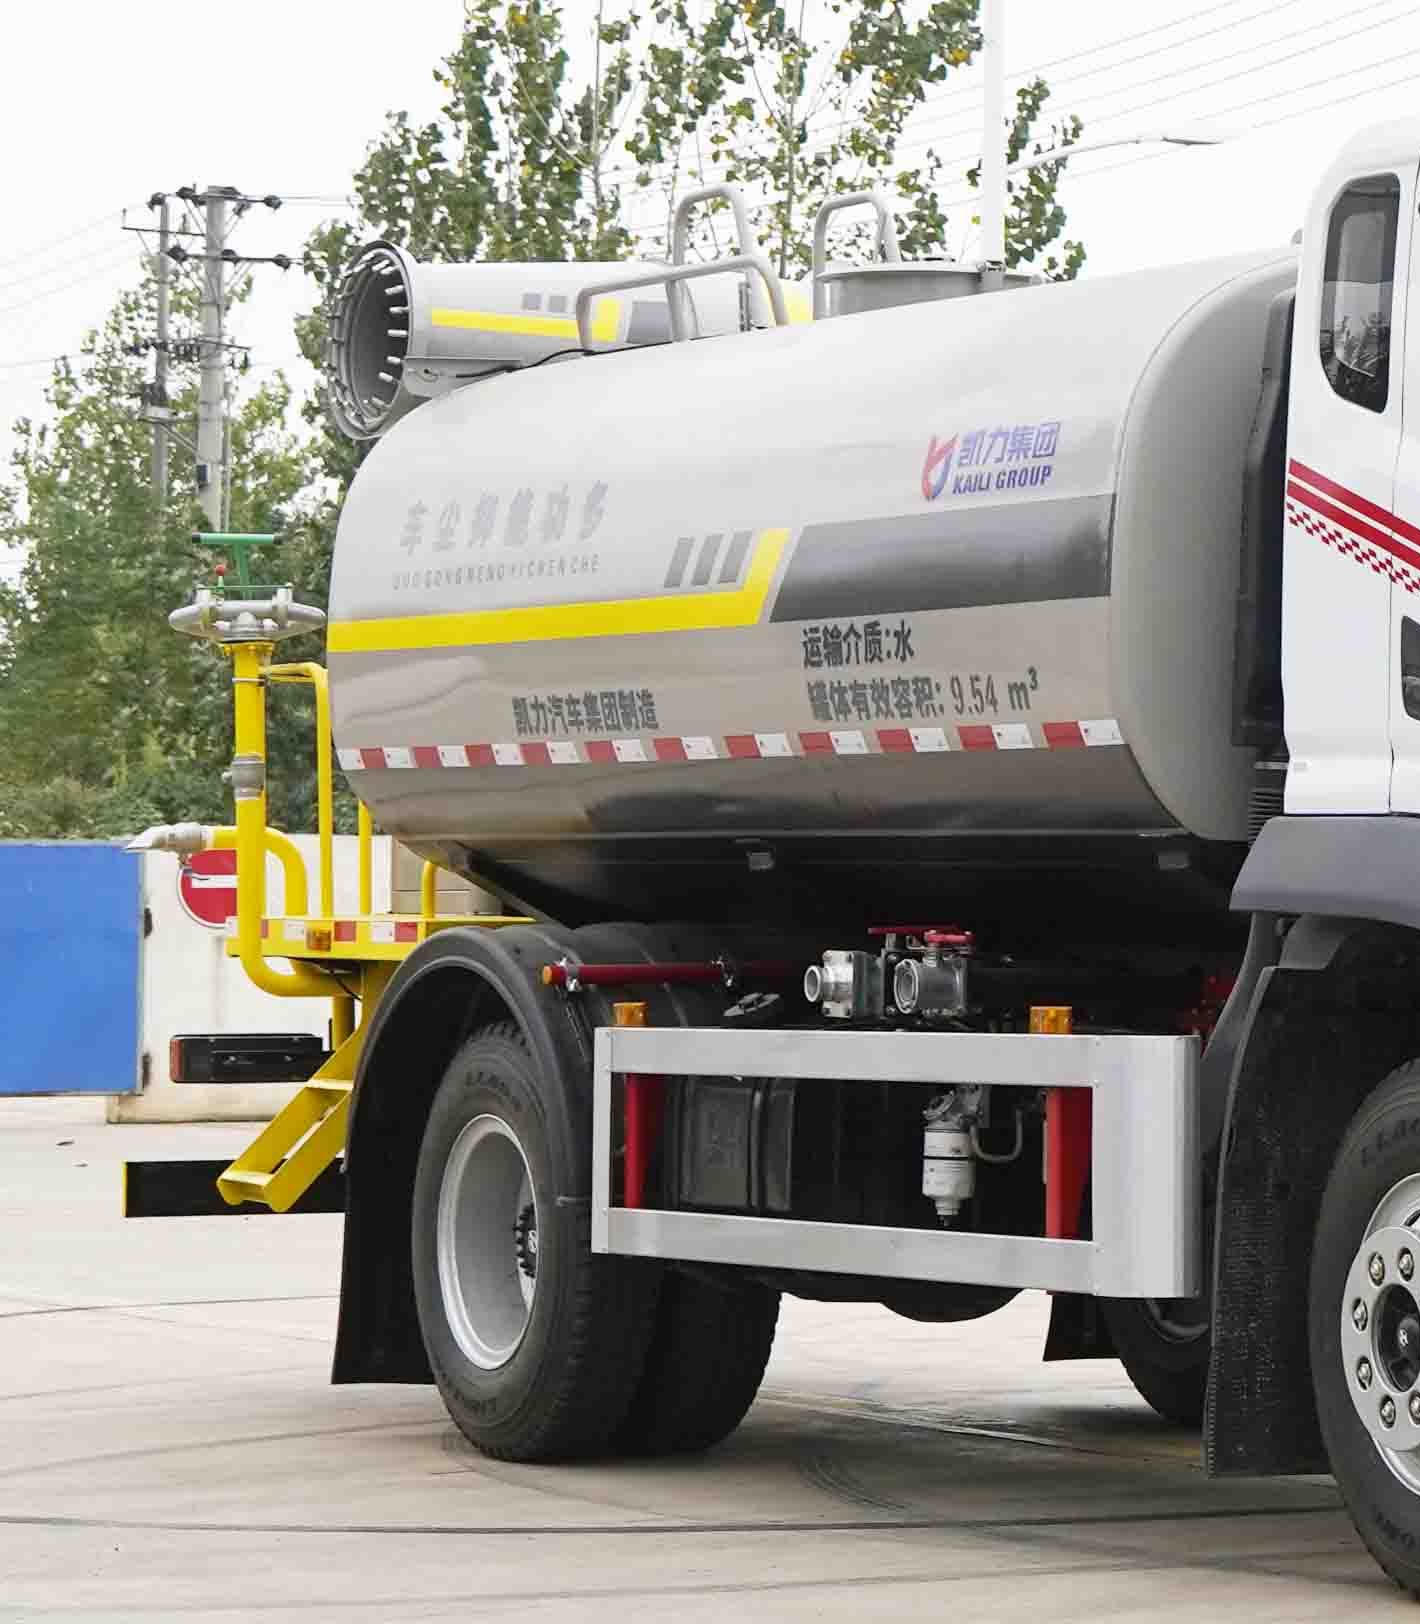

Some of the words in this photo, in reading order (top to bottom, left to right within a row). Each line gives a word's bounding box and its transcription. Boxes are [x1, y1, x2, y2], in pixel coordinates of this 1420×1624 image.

[958, 421, 1062, 467] 凯力集团
[952, 471, 992, 494] KAILI
[996, 464, 1052, 489] GROUP
[511, 688, 659, 736] 凯力汽车集团制造
[951, 675, 999, 715] 9.54
